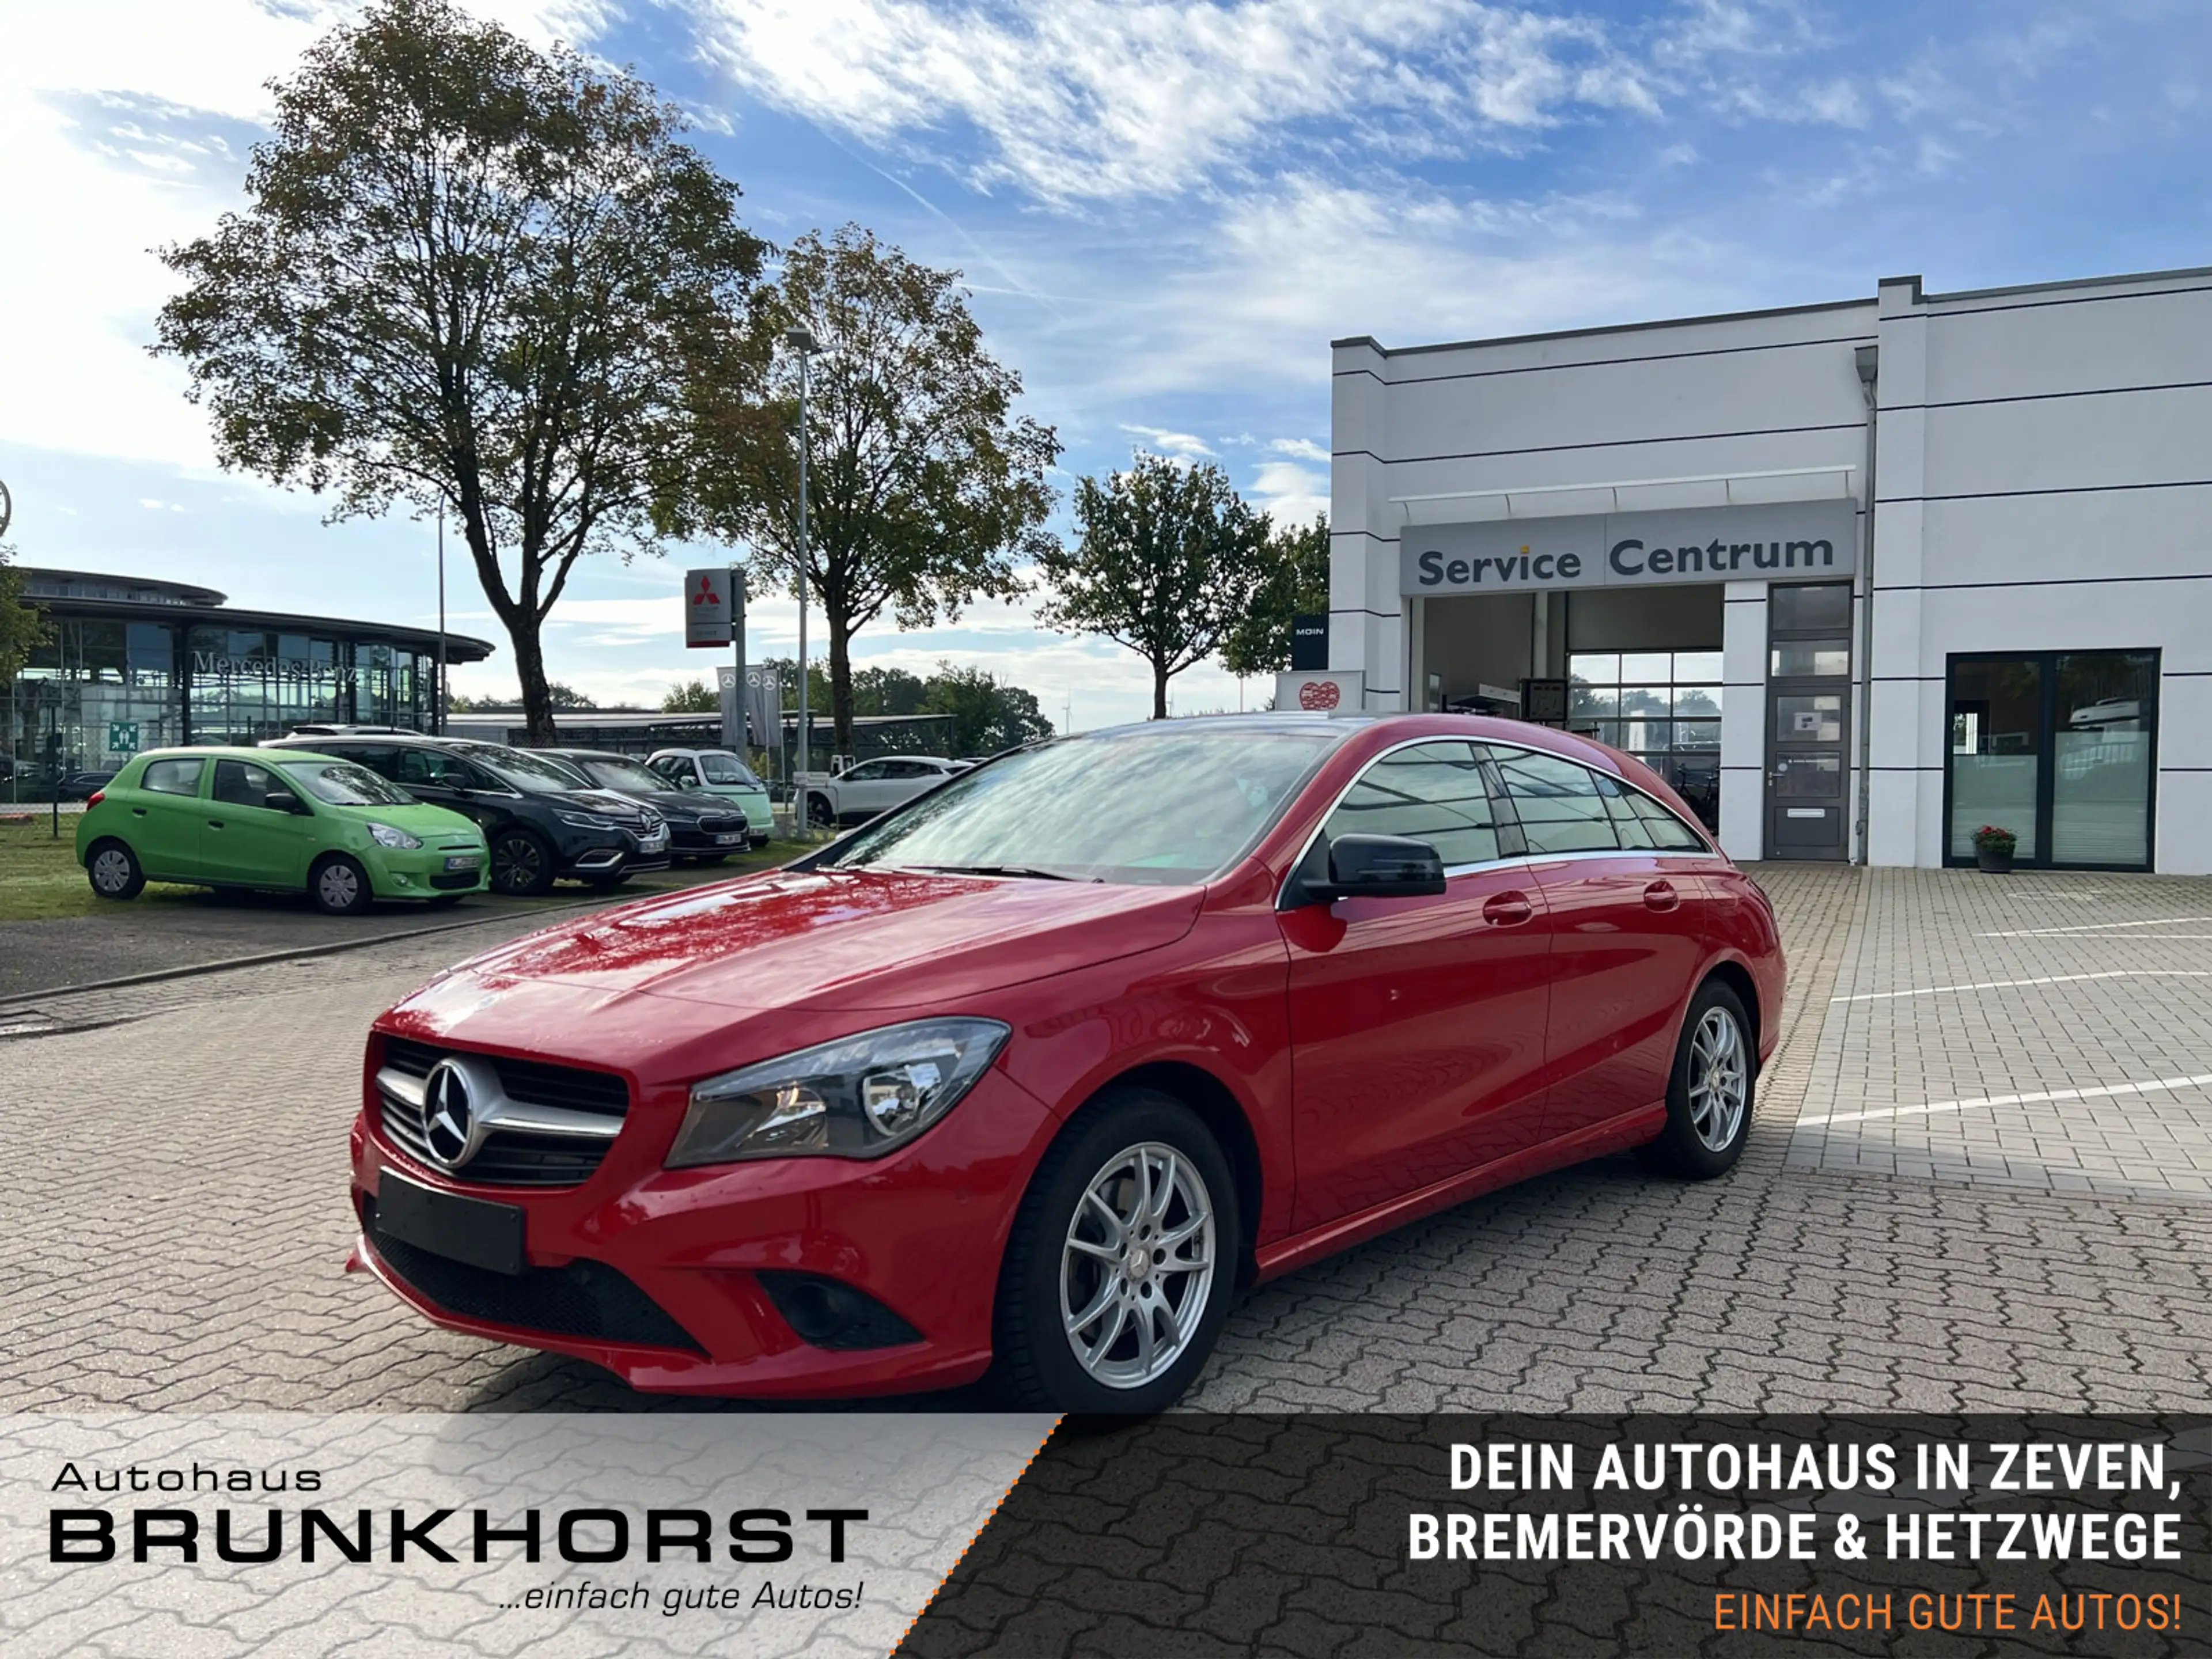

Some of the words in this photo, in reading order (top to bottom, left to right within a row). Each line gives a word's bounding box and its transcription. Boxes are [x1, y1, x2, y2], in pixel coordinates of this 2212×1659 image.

[1418, 545, 1582, 586] Service
[1609, 539, 1834, 576] Centrum
[192, 651, 357, 683] Mercedes-Benz
